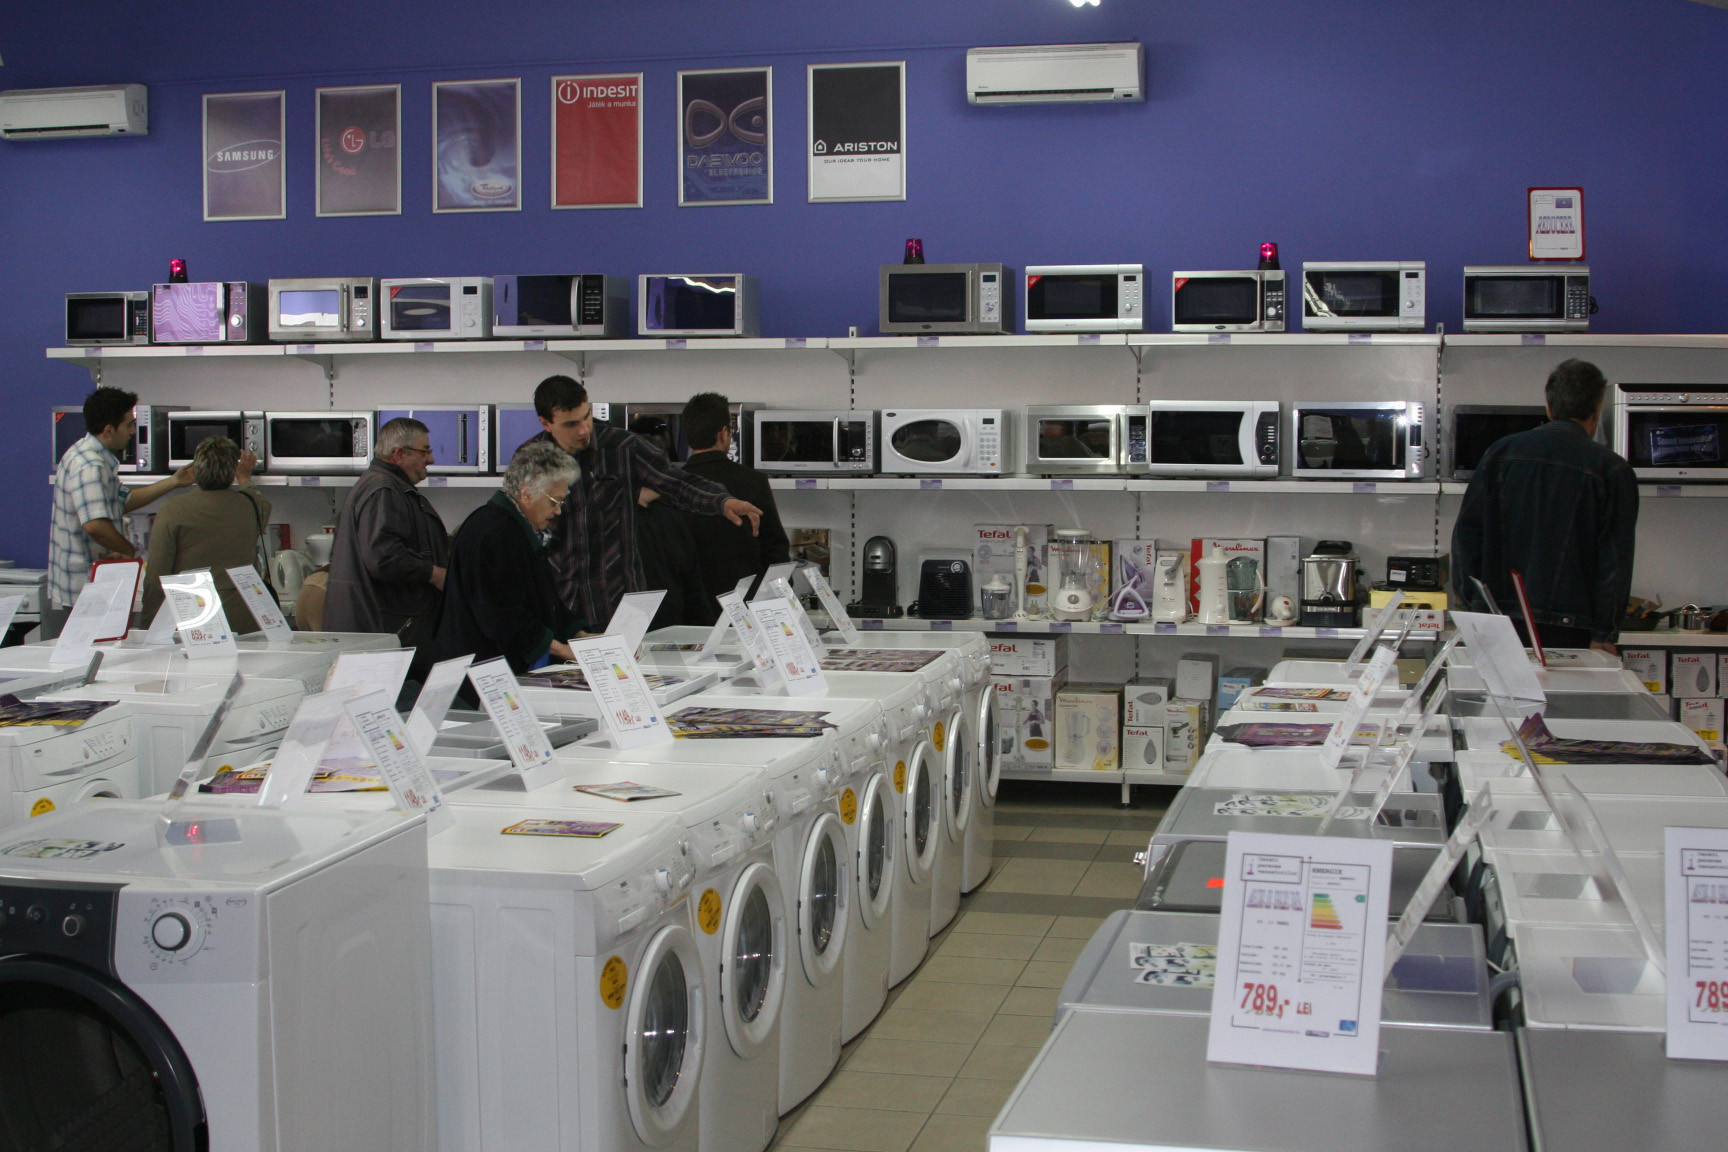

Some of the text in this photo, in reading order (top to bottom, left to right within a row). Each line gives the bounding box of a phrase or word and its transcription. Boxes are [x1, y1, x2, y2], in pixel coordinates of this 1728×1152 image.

[369, 130, 396, 148] LG
[833, 141, 898, 153] ARISTON
[217, 149, 274, 162] SAMSUNG
[687, 152, 764, 168] DAEWOO
[978, 529, 1012, 539] Tefal
[991, 644, 1018, 653] efal
[994, 683, 1014, 692] fal
[1296, 1001, 1313, 1015] LEI
